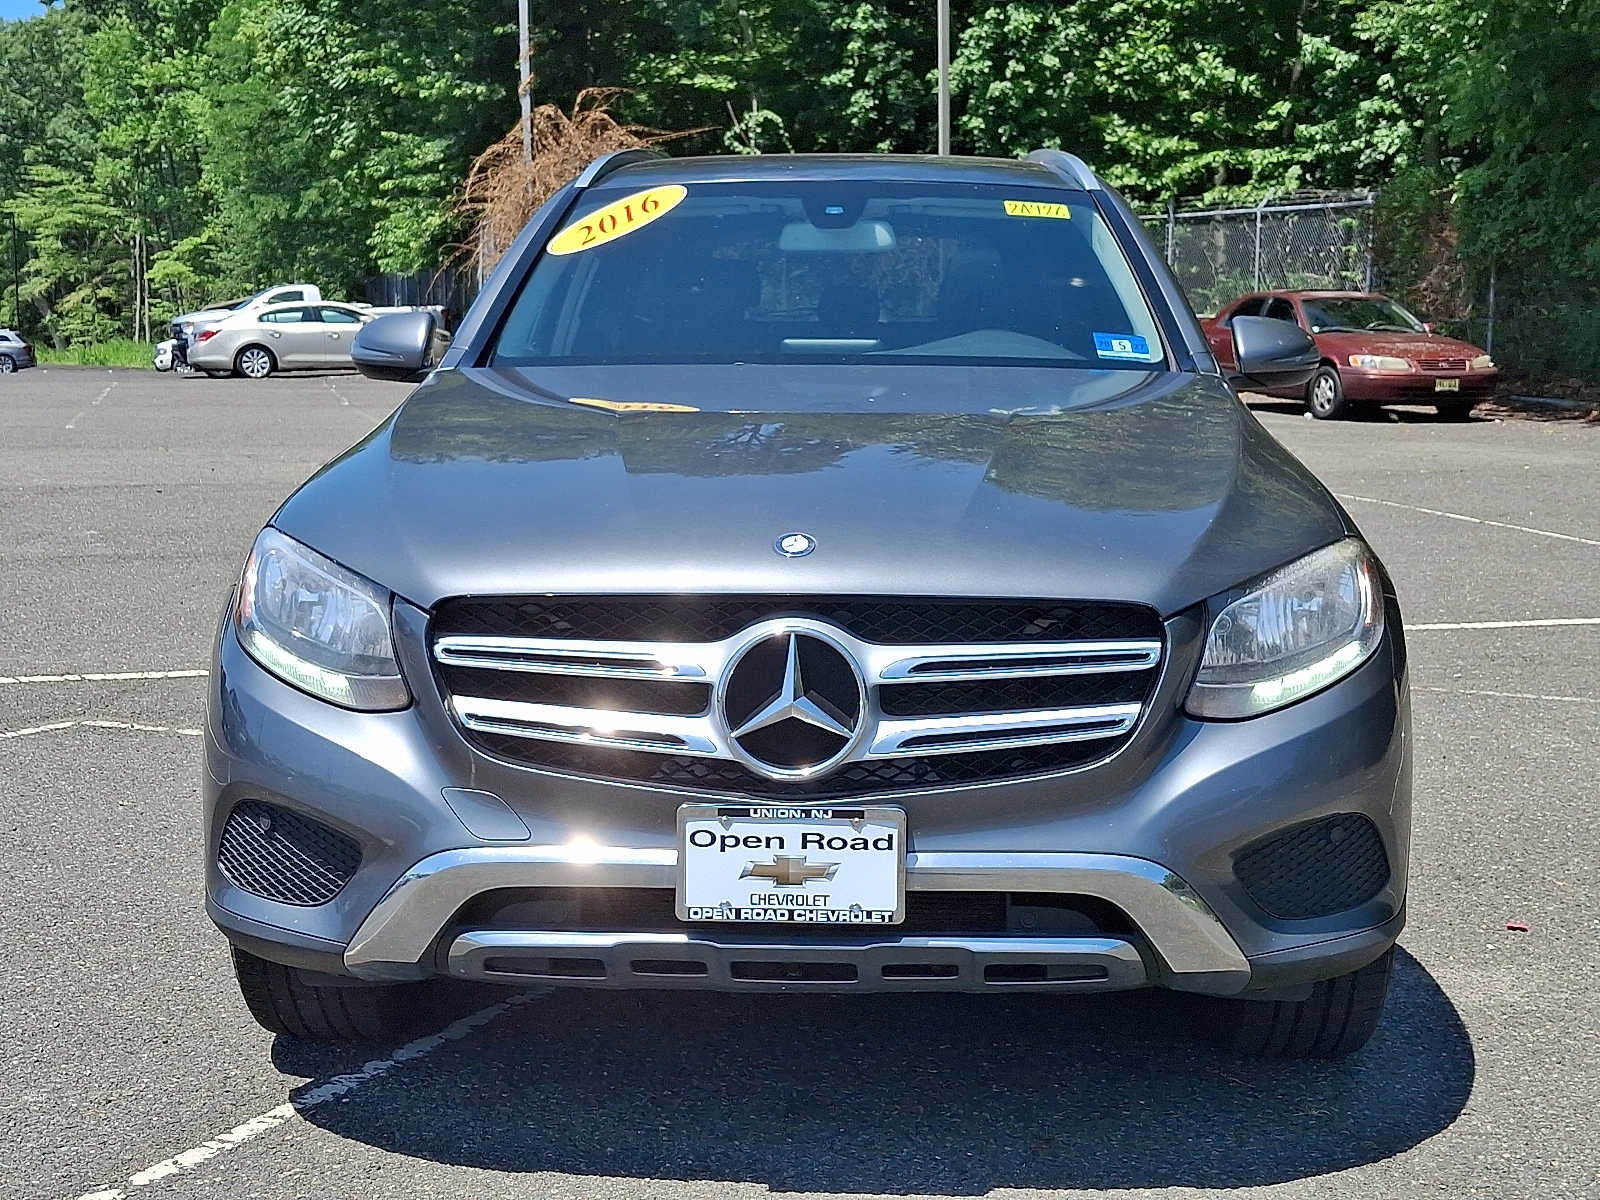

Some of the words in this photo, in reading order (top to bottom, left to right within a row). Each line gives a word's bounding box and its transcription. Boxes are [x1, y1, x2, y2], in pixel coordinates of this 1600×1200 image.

[578, 195, 660, 245] 2016
[1118, 341, 1126, 351] 5
[811, 809, 833, 819] NJ
[689, 829, 785, 852] Open
[801, 832, 894, 851] Road
[750, 893, 830, 906] CHEVROLET
[689, 907, 736, 921] OPEN
[740, 908, 789, 921] ROAD
[793, 908, 893, 923] CHEVROLET
